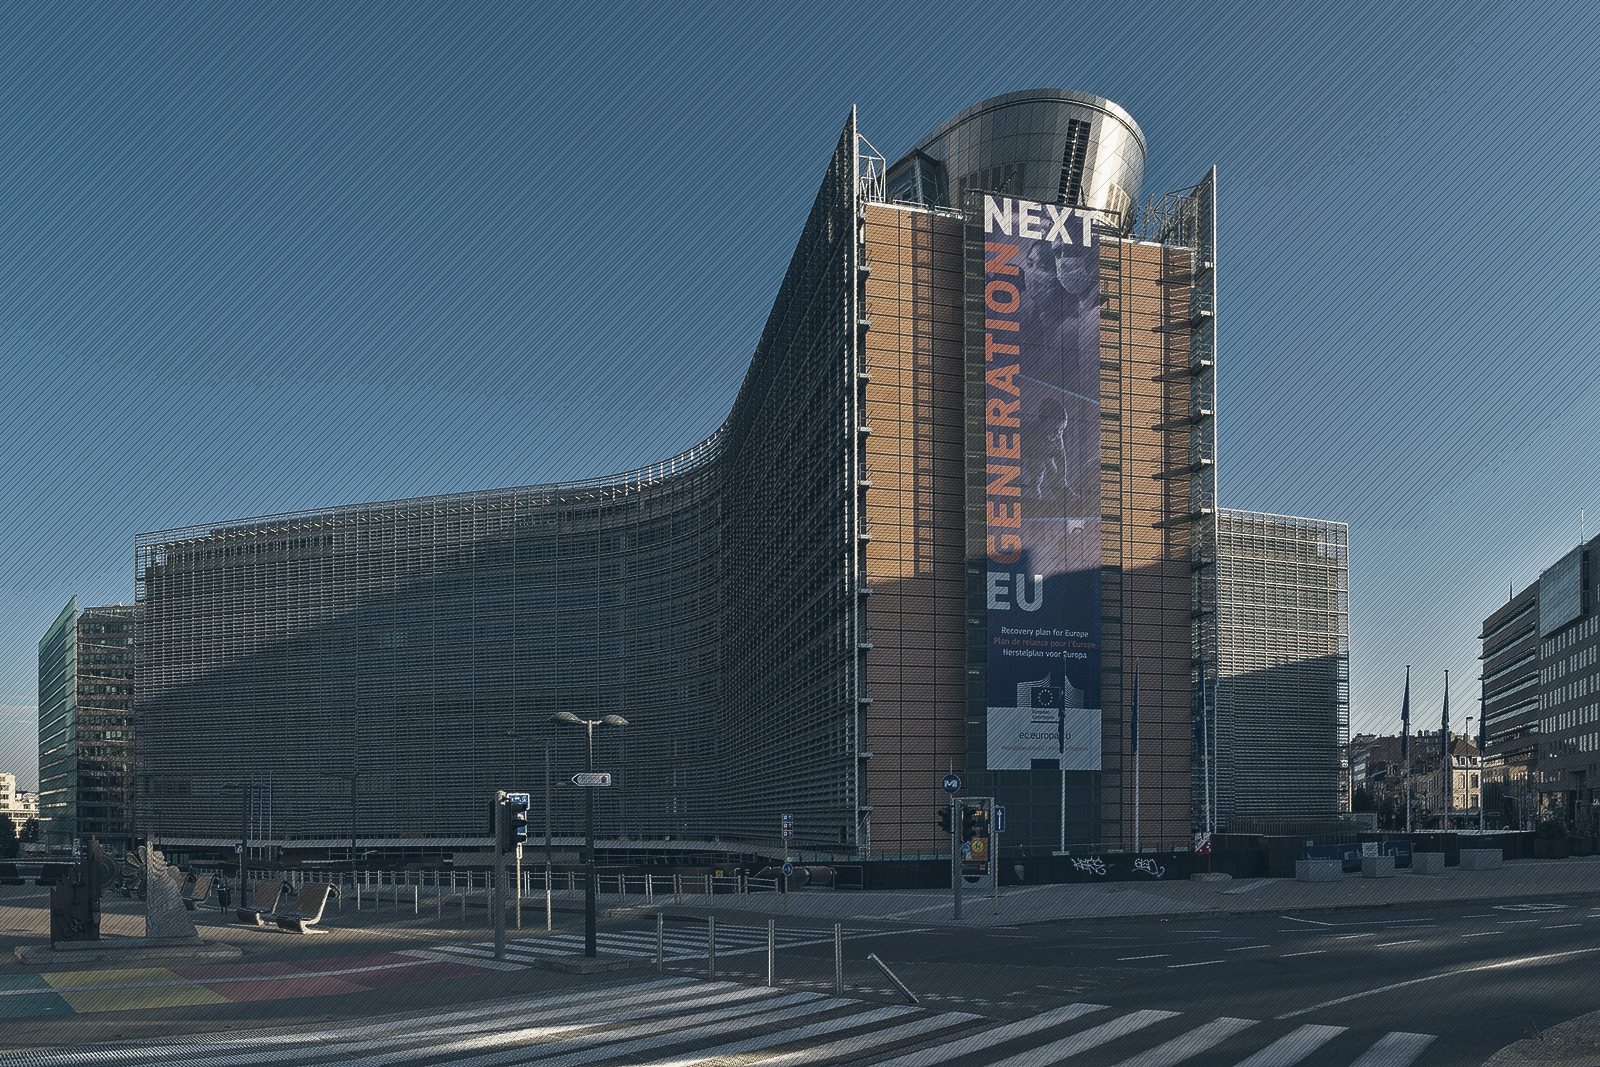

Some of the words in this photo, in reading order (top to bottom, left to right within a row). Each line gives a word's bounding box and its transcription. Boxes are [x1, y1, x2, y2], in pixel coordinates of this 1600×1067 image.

[984, 195, 1100, 248] NEXT
[985, 241, 1021, 565] GENERATION
[986, 571, 1044, 612] EU
[993, 637, 1010, 645] Plan
[1050, 640, 1067, 648] pour
[1001, 626, 1034, 636] Recovery
[1035, 628, 1051, 637] plan
[1052, 628, 1063, 636] for
[1064, 629, 1089, 638] Europe
[1002, 648, 1044, 658] Herstelplan
